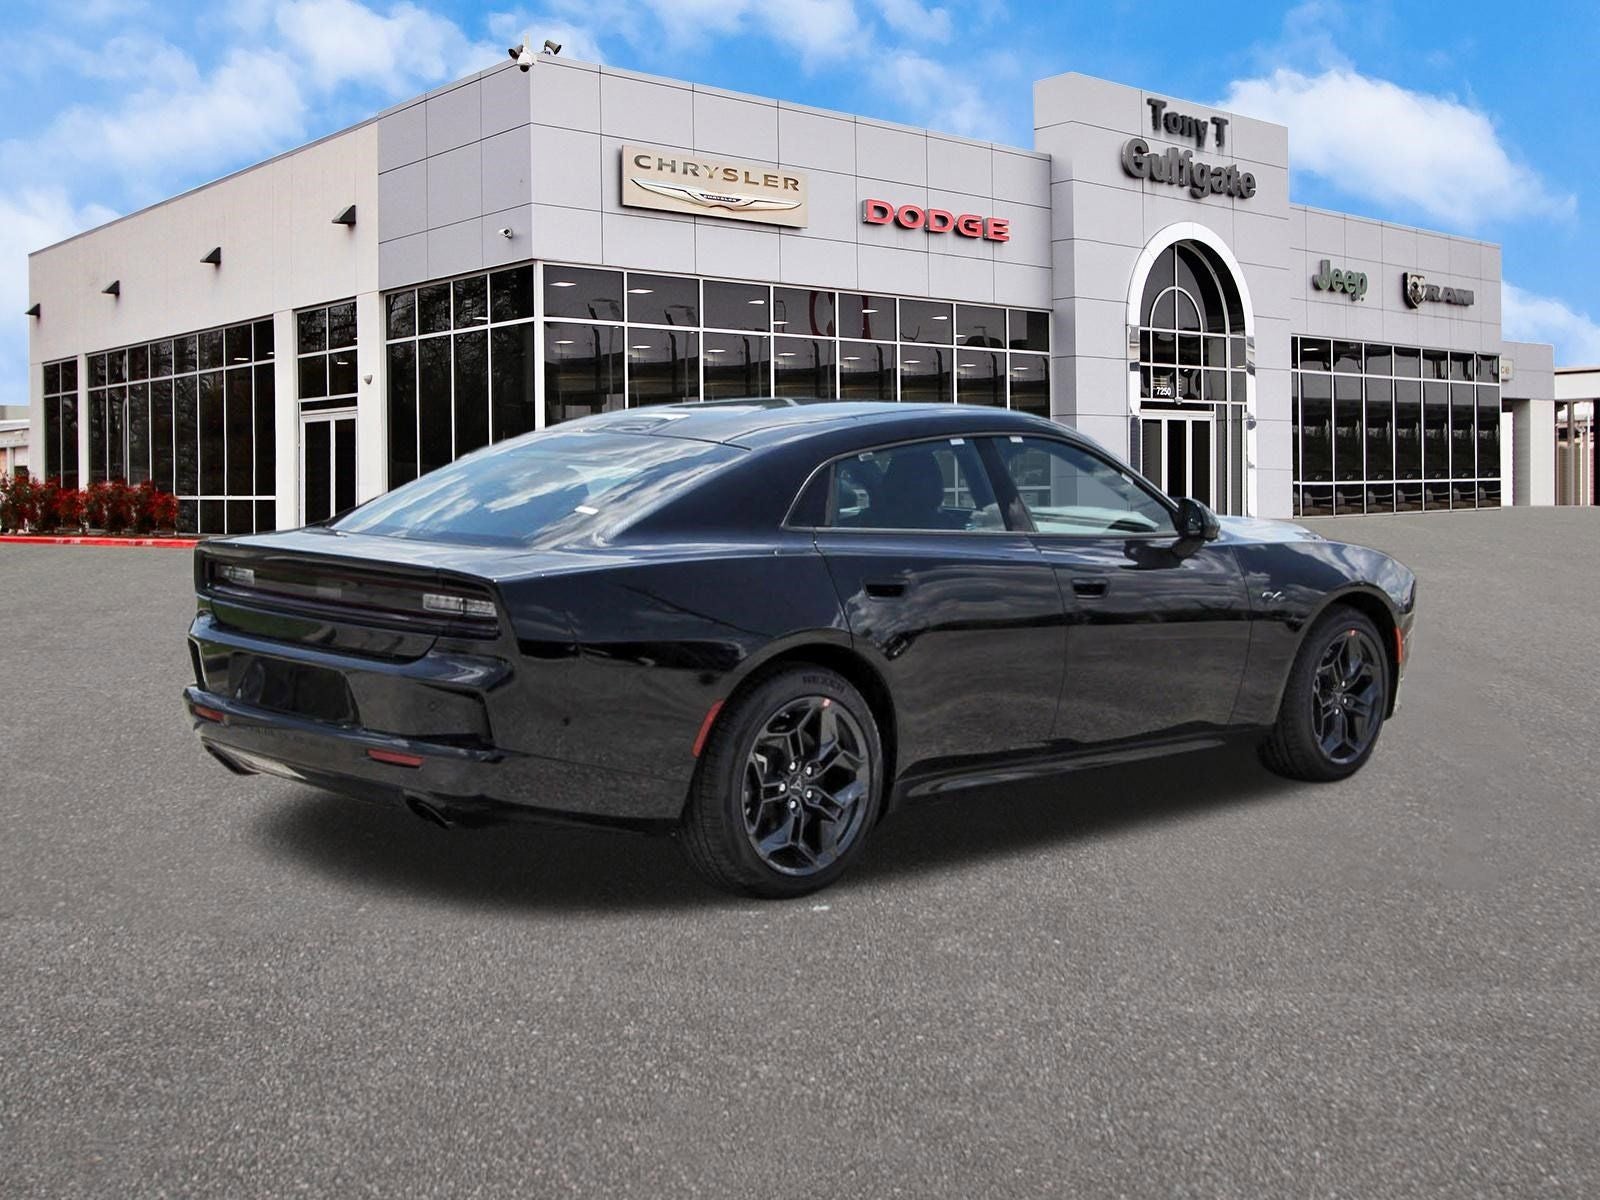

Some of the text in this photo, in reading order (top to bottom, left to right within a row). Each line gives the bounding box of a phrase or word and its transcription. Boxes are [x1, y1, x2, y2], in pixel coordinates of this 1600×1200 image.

[1147, 98, 1229, 147] Tony T
[633, 154, 800, 192] CHRYSLER
[1121, 137, 1257, 198] Gulfgate
[862, 198, 1010, 243] DODGE
[1312, 259, 1368, 302] Jeep
[1425, 283, 1475, 307] RAM
[1156, 386, 1172, 396] 7250
